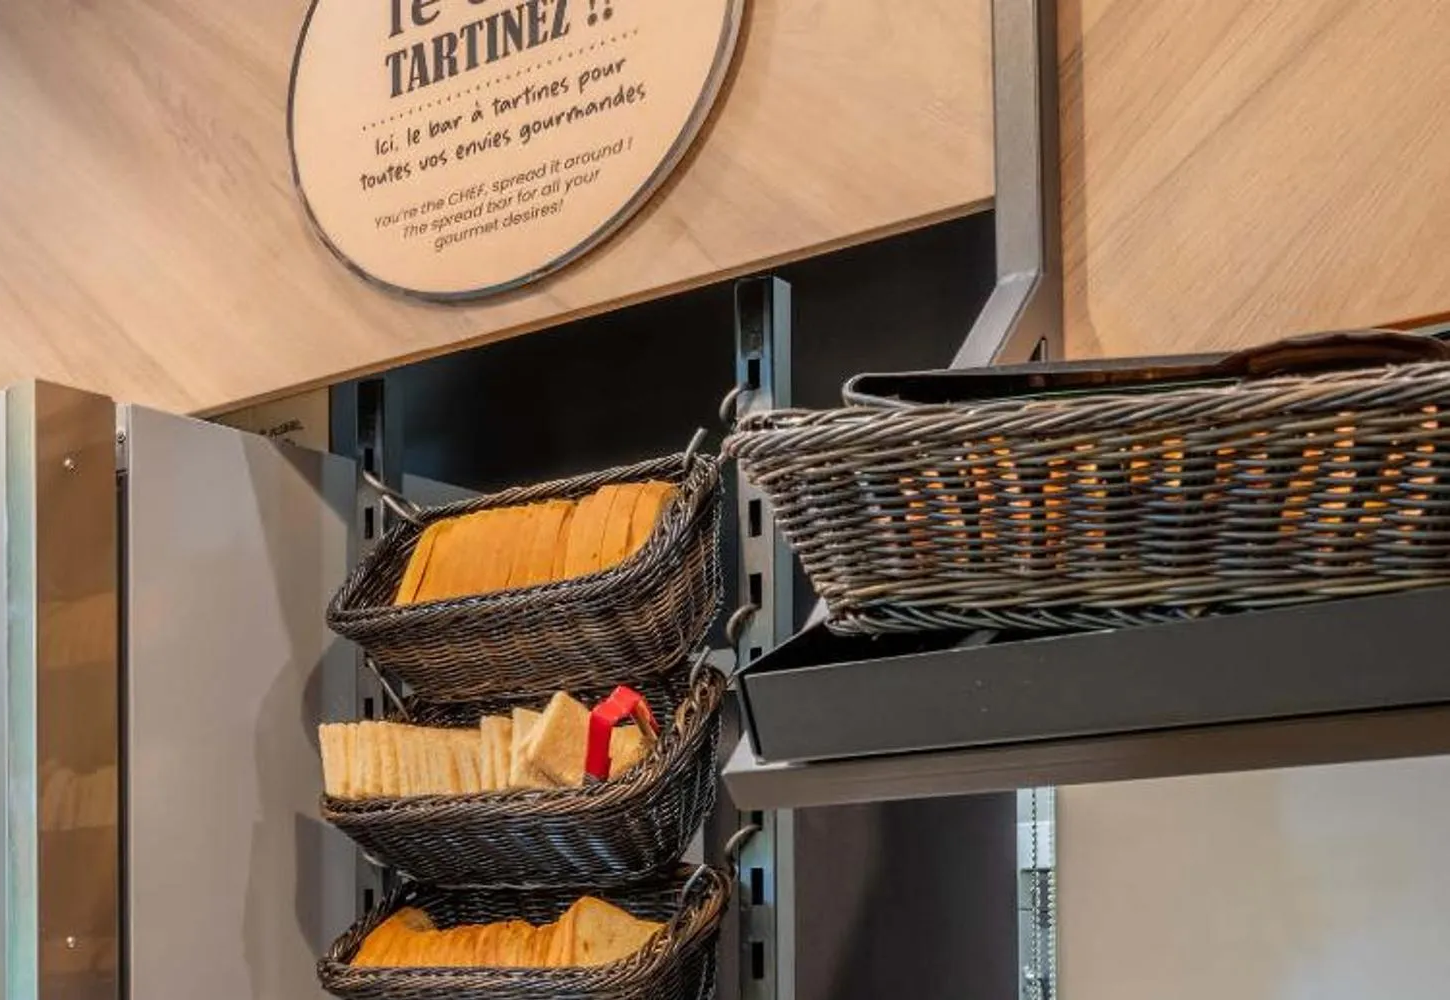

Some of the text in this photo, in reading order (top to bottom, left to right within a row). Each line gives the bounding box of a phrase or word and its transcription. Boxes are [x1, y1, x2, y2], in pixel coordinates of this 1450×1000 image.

[385, 0, 571, 98] TARTINEZ
[360, 80, 646, 191] toutes vos envies gourmandes
[407, 128, 421, 146] le
[429, 115, 463, 138] bar
[471, 101, 484, 124] à
[492, 77, 569, 116] tartines
[578, 58, 627, 93] pour
[402, 168, 602, 240] The spread bar for all your
[421, 197, 445, 213] the
[492, 163, 547, 197] spread
[550, 157, 561, 174] it
[564, 140, 623, 169] around
[434, 217, 500, 252] gourmet
